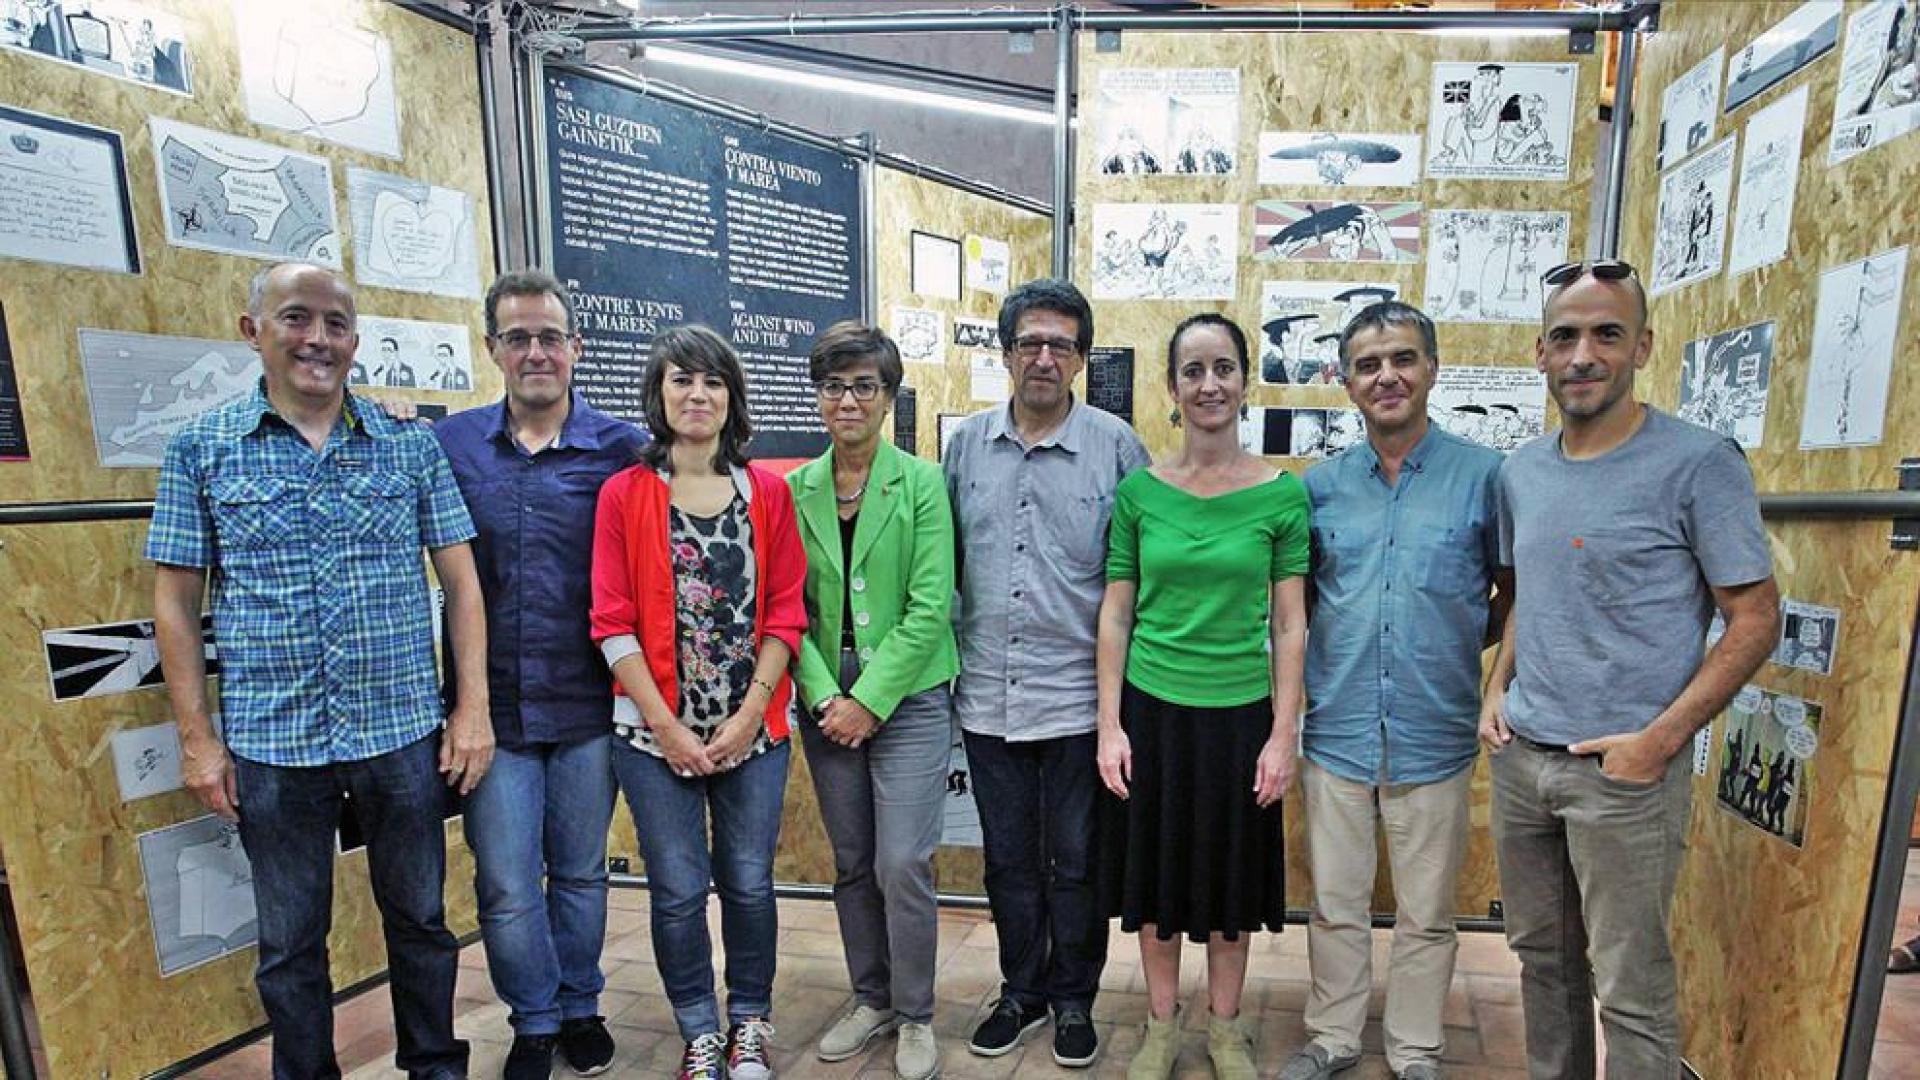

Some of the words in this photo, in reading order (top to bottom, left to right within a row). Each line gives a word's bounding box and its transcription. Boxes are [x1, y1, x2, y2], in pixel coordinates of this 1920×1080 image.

[555, 102, 593, 127] SASI
[595, 112, 662, 145] GUZTIEN
[724, 147, 777, 175] CONTRA
[778, 160, 822, 186] VIENTO
[725, 164, 735, 180] Y
[738, 167, 781, 193] MAREA
[570, 292, 634, 315] CONTRE
[636, 298, 684, 321] VENTS
[574, 311, 593, 329] ET
[731, 311, 782, 331] AGAINST
[783, 317, 816, 337] WIND
[732, 328, 759, 344] AND
[760, 331, 790, 348] TIDE
